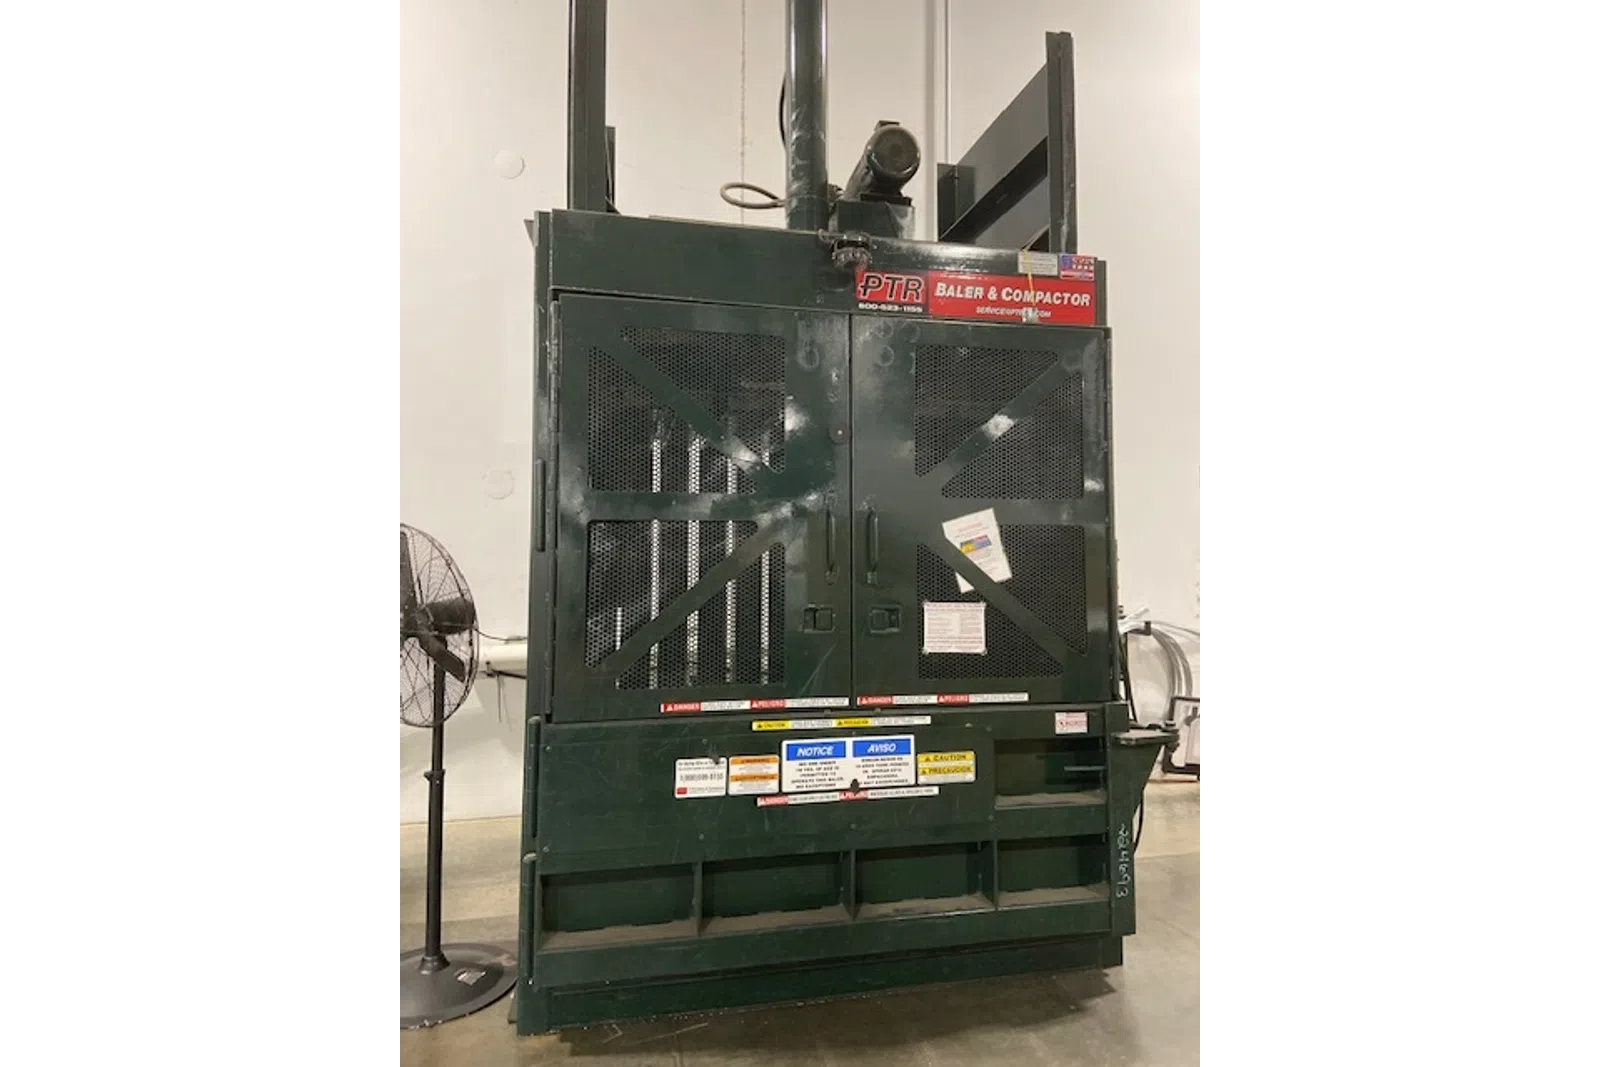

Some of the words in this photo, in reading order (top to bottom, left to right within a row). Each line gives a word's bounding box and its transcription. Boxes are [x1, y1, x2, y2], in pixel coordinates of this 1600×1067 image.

[857, 273, 925, 302] PTR
[934, 281, 984, 299] BALER
[987, 285, 998, 299] &
[1001, 286, 1091, 307] COMPACTOR
[797, 745, 834, 757] NOTICE
[867, 742, 897, 754] AVISO
[933, 753, 967, 761] CAUTION
